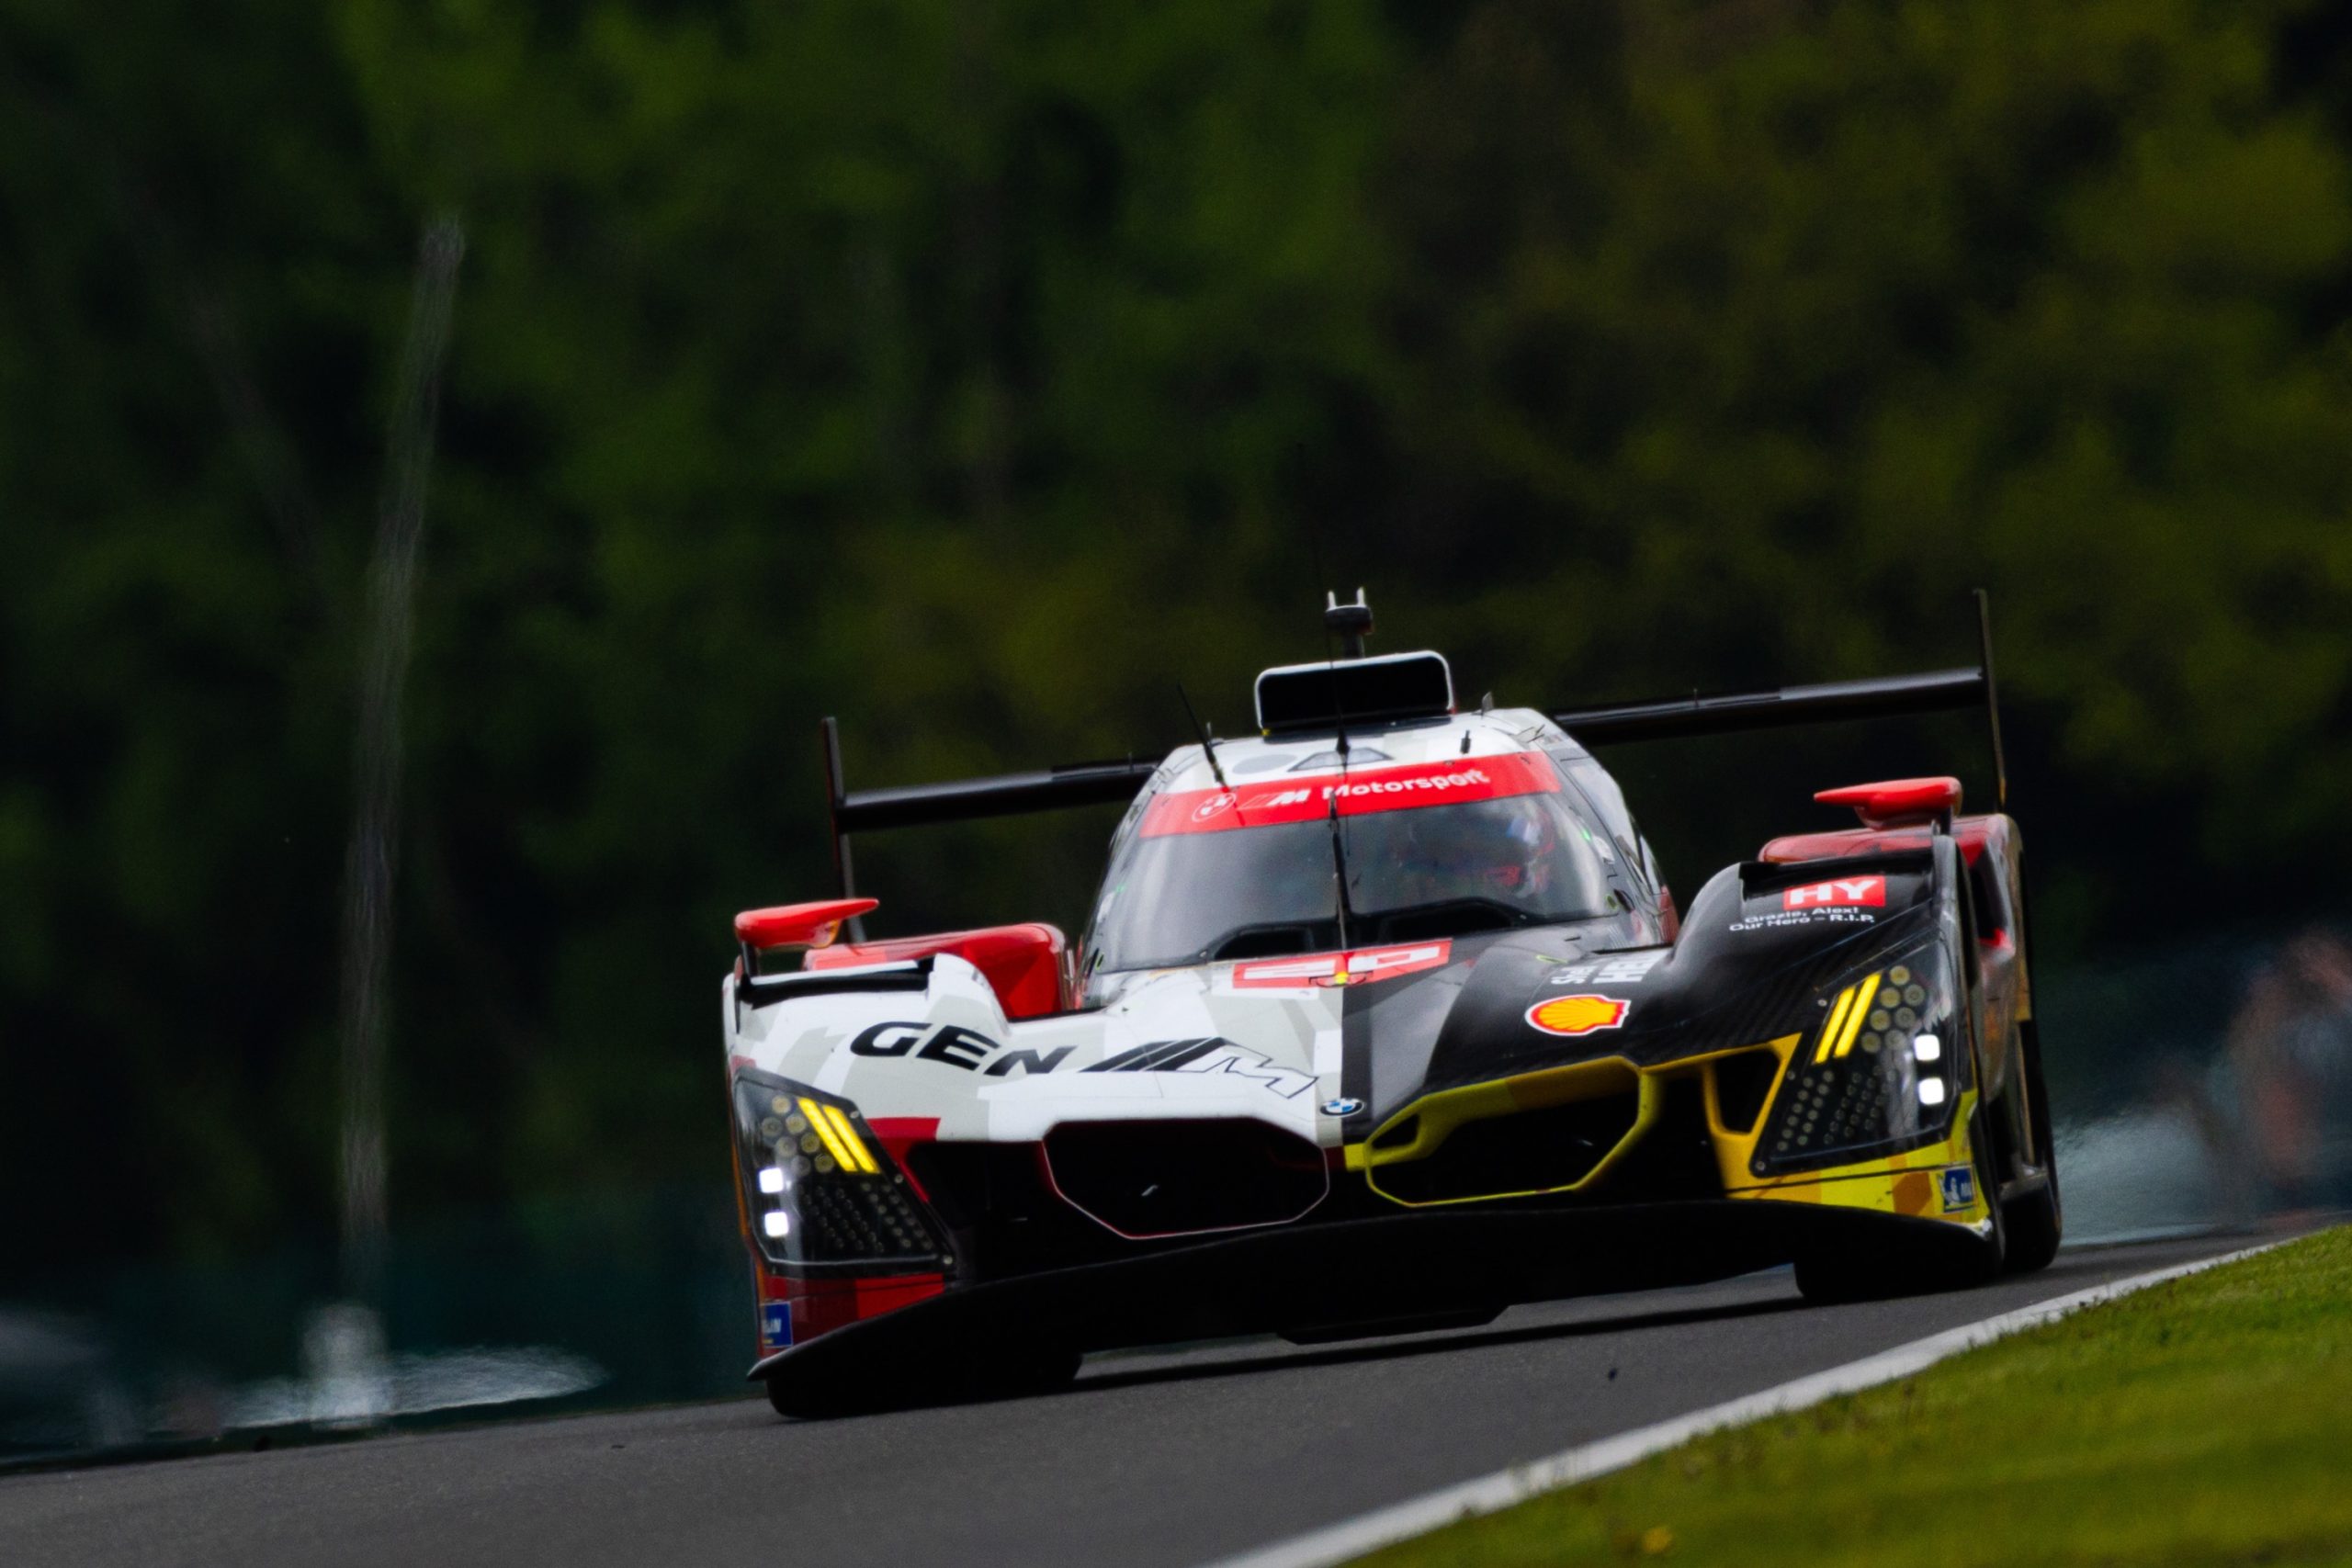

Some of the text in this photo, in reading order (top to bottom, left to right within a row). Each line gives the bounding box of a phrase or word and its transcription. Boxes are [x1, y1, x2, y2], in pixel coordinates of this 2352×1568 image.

[1321, 768, 1490, 800] Motorsport
[1790, 879, 1878, 905] HY
[1729, 922, 1764, 931] Our
[1767, 916, 1810, 927] Hero
[850, 1021, 1078, 1077] GEN
